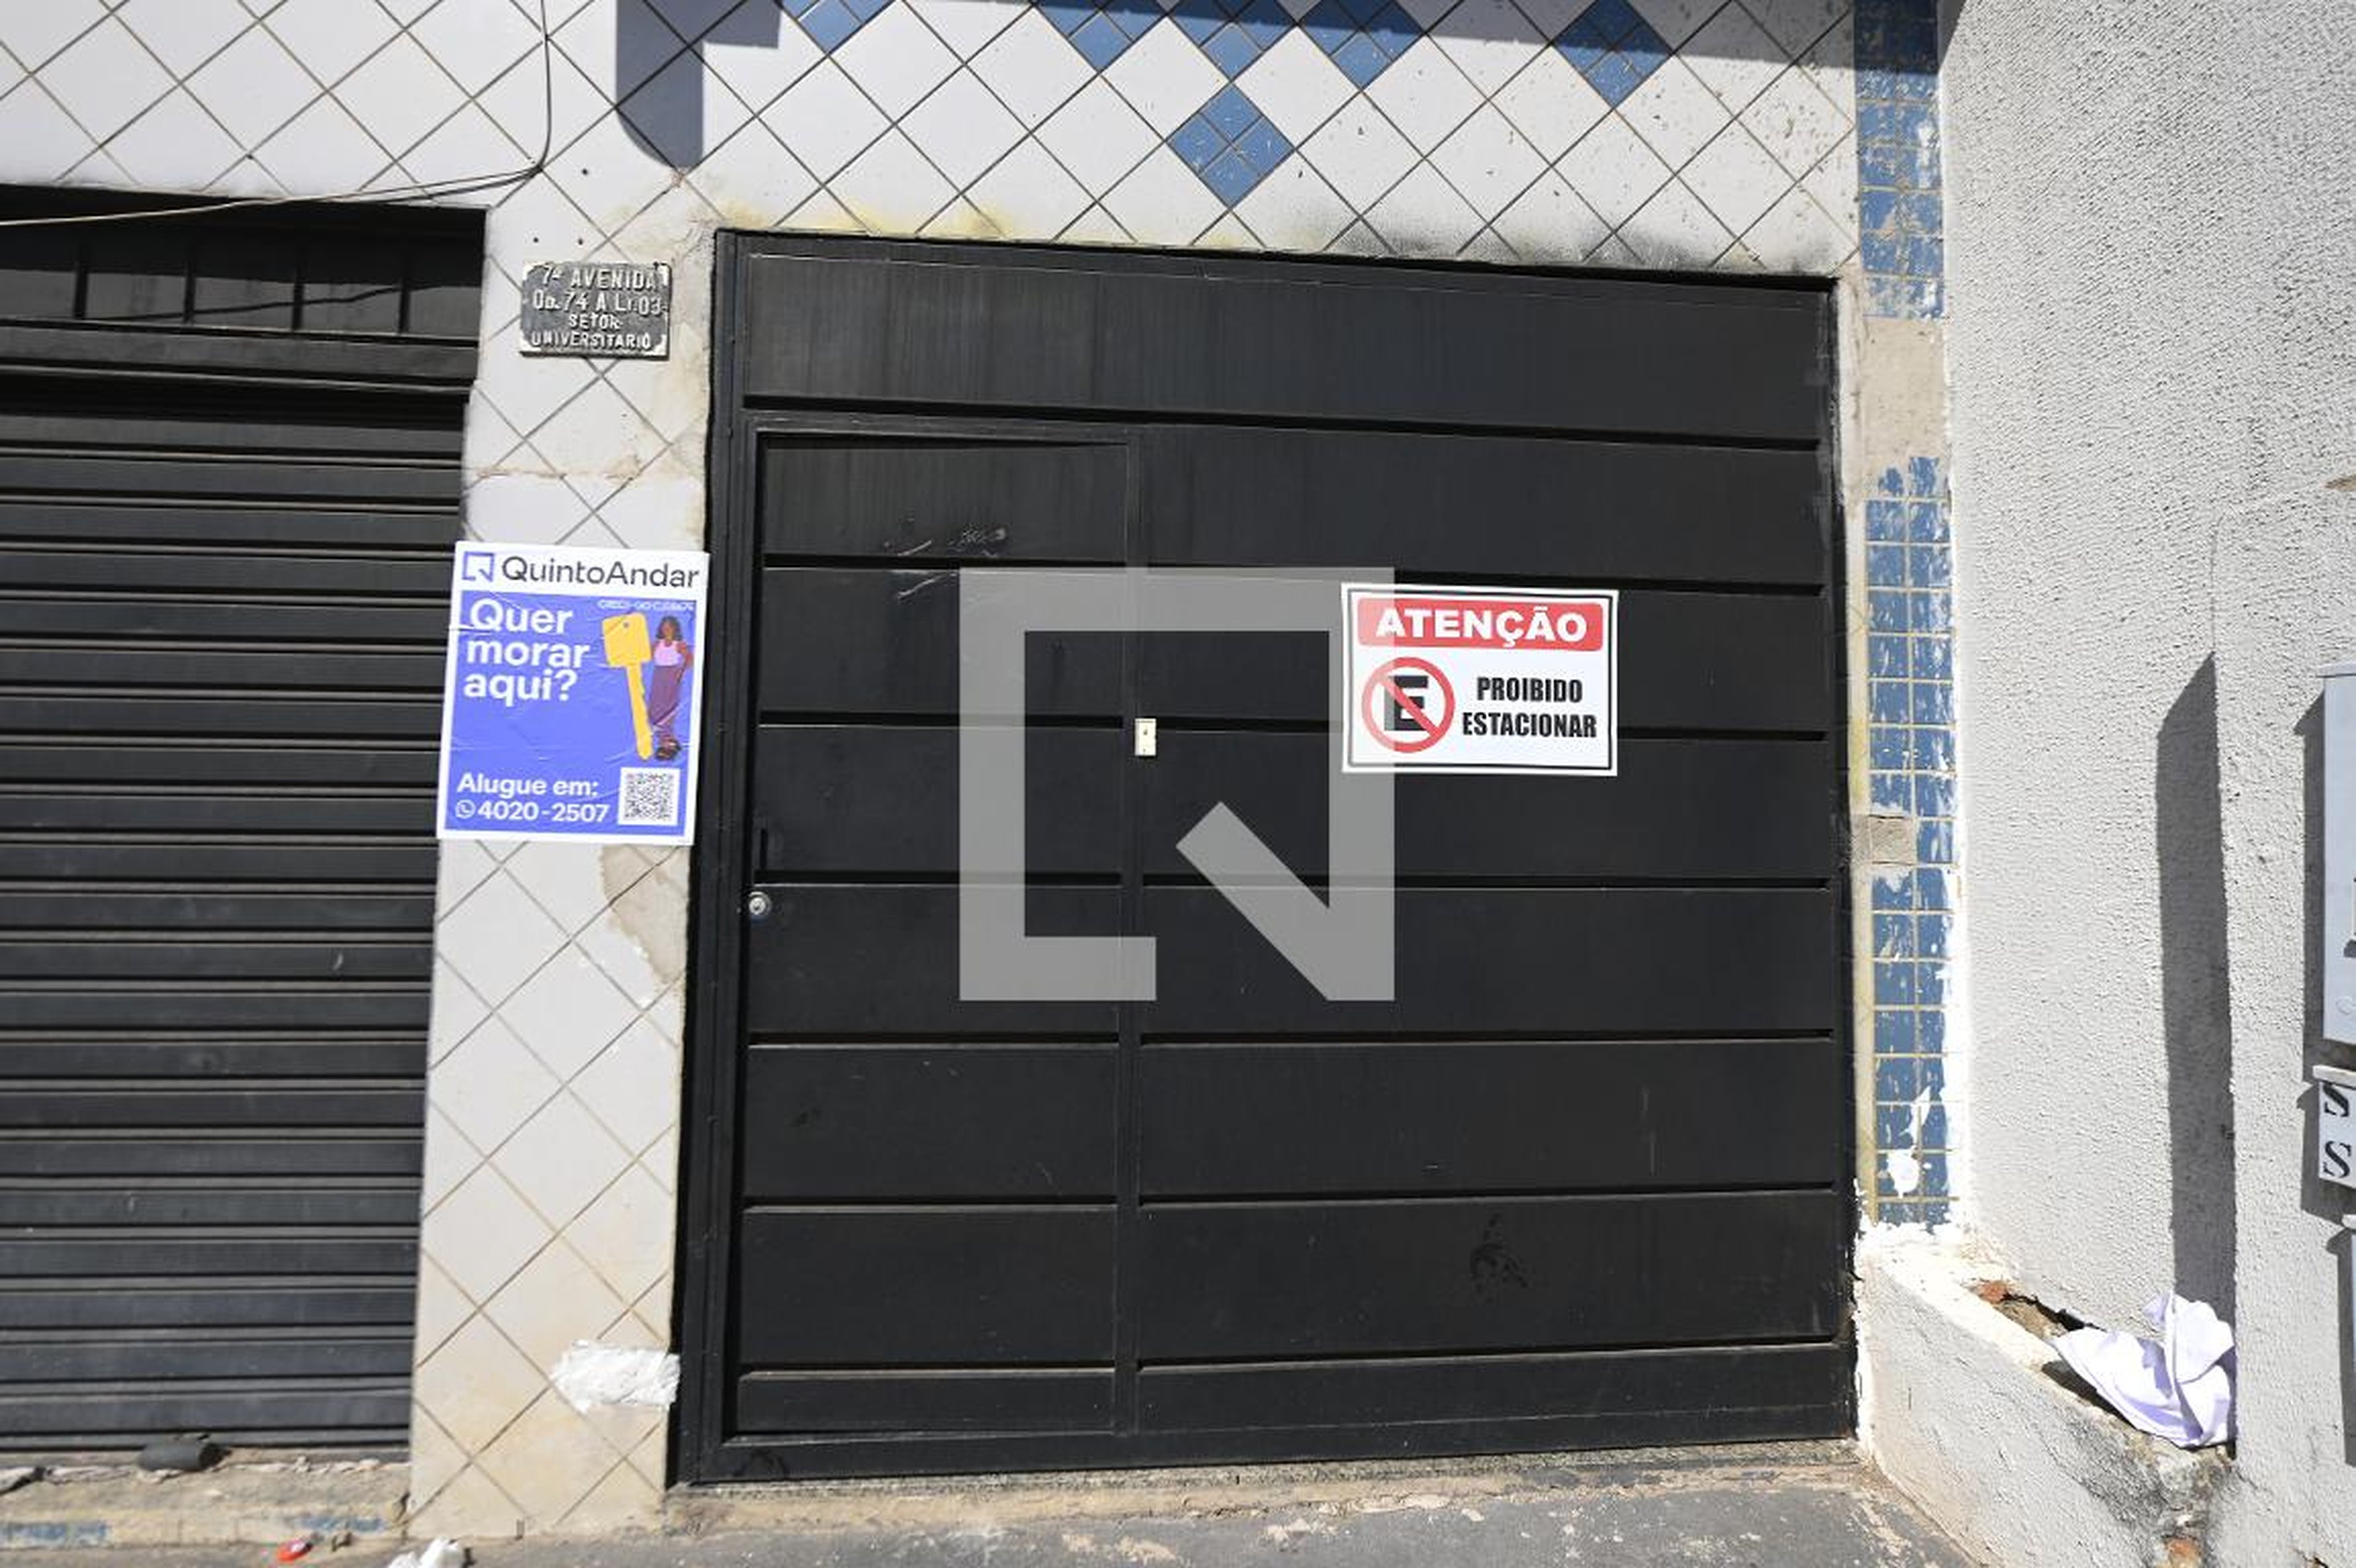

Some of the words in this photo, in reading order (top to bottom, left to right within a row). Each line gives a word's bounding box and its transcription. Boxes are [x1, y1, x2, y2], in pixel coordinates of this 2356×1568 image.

[571, 267, 656, 290] AVENIDA
[569, 313, 623, 330] SETOR
[531, 330, 651, 349] UNIVERSITARIO
[502, 556, 699, 589] QuintoAndar
[470, 598, 573, 634] Quer
[1375, 605, 1587, 647] ATENÇÃO
[466, 638, 590, 669] morar
[463, 669, 577, 707] aqui?
[1476, 676, 1583, 703] PROIBIDO
[1461, 712, 1597, 738] ESTACIONAR
[456, 772, 547, 799] Alugue
[552, 779, 599, 797] em:
[477, 801, 610, 822] 4020-2507
